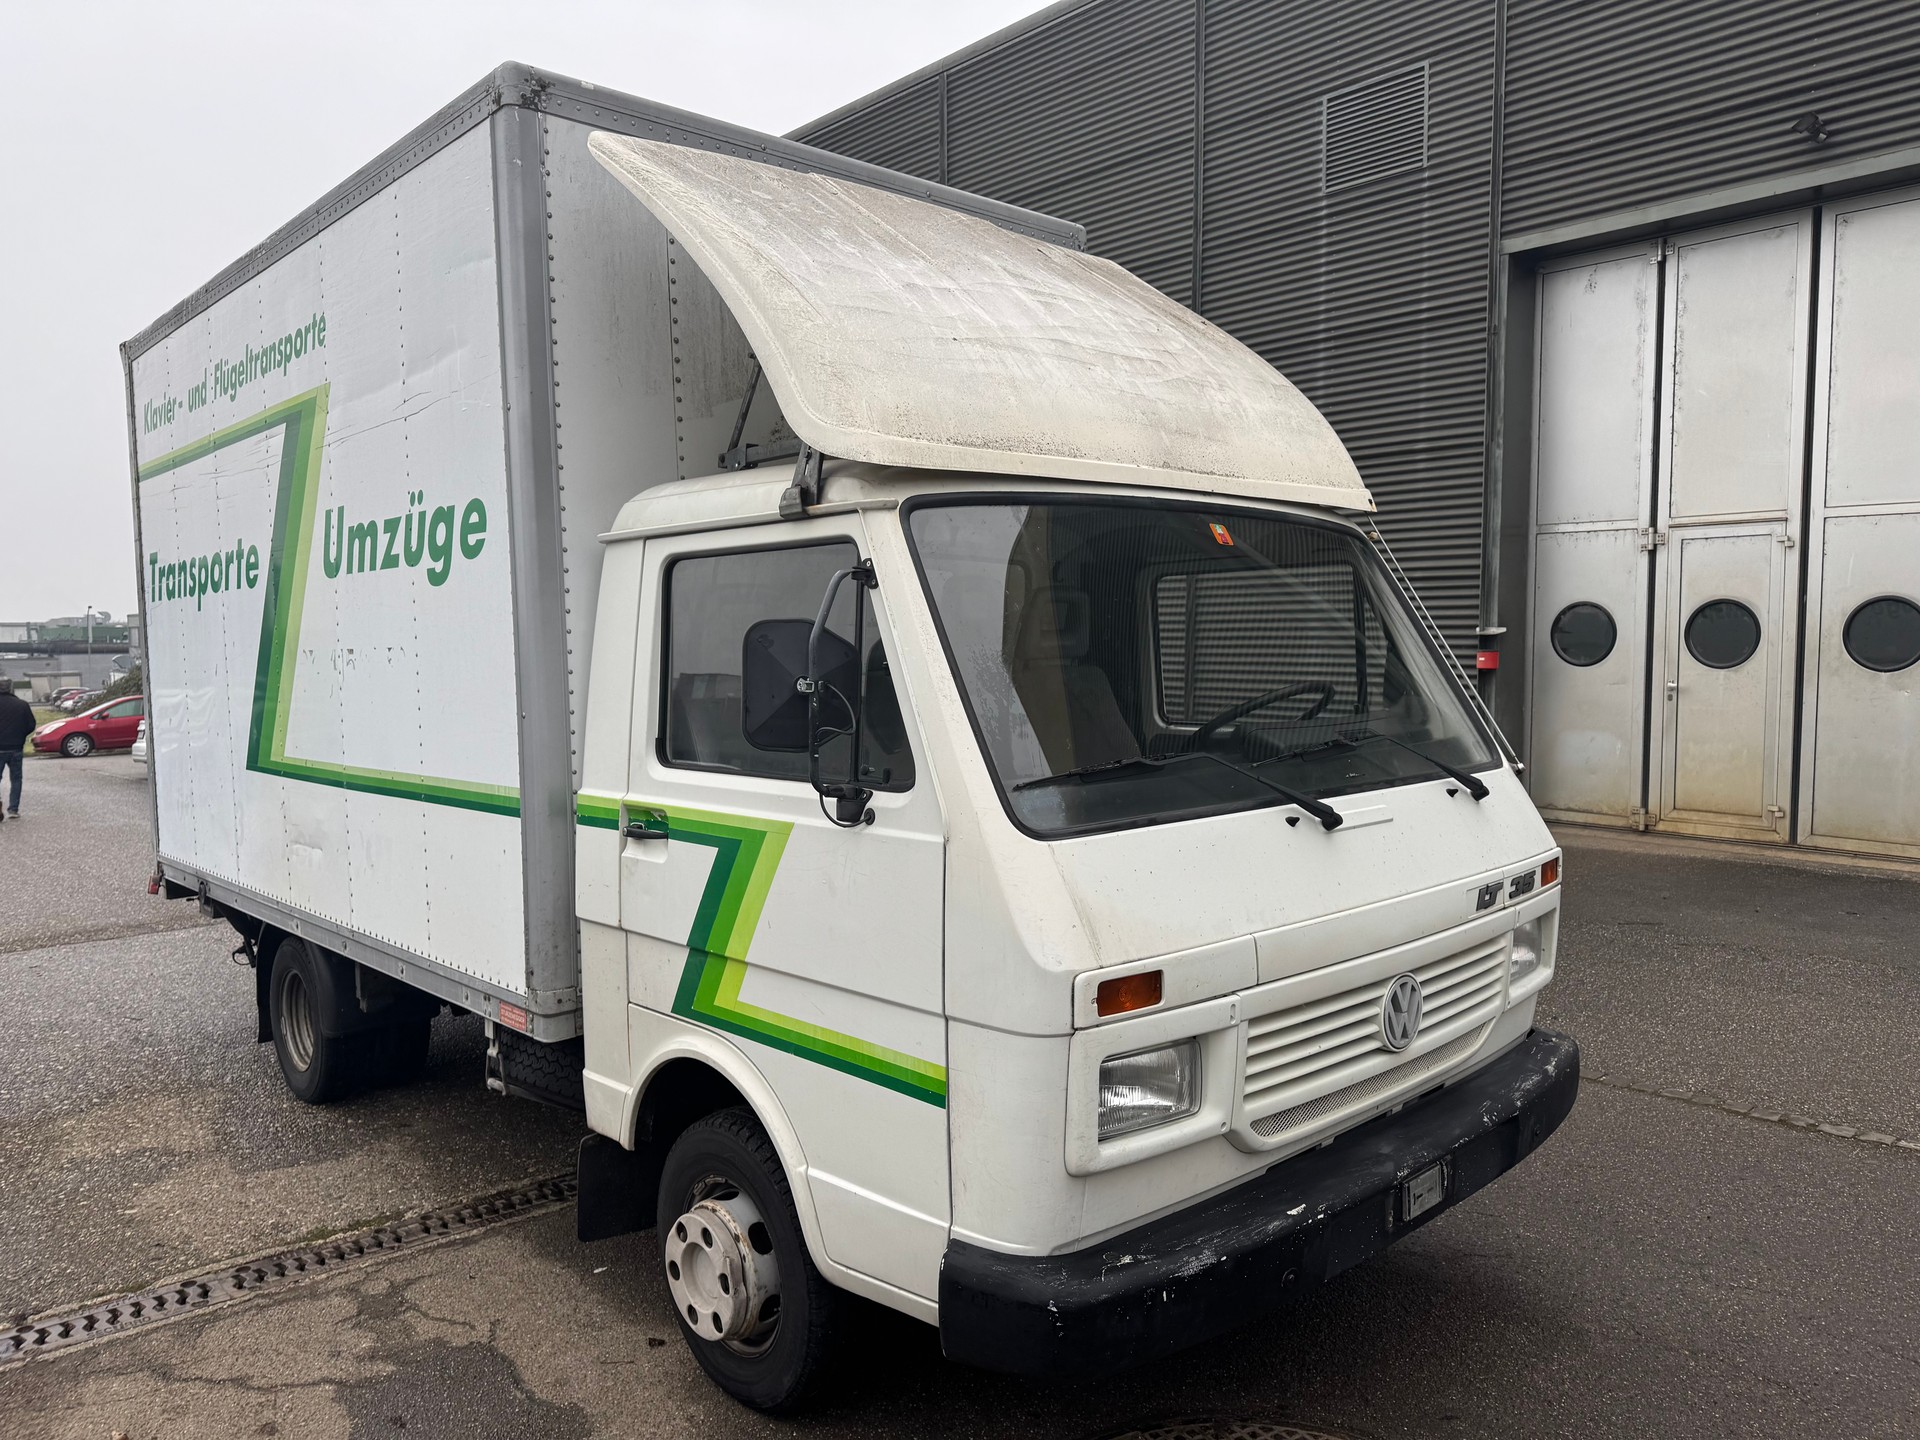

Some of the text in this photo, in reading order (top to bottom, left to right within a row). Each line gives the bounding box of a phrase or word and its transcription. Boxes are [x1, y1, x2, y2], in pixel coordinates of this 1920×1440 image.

[144, 312, 327, 435] Klavier- und Flügeltransporte
[149, 537, 259, 612] Transporte
[322, 489, 488, 587] Umzüge
[1476, 870, 1536, 912] LT 35
[1383, 976, 1422, 1049] VW
